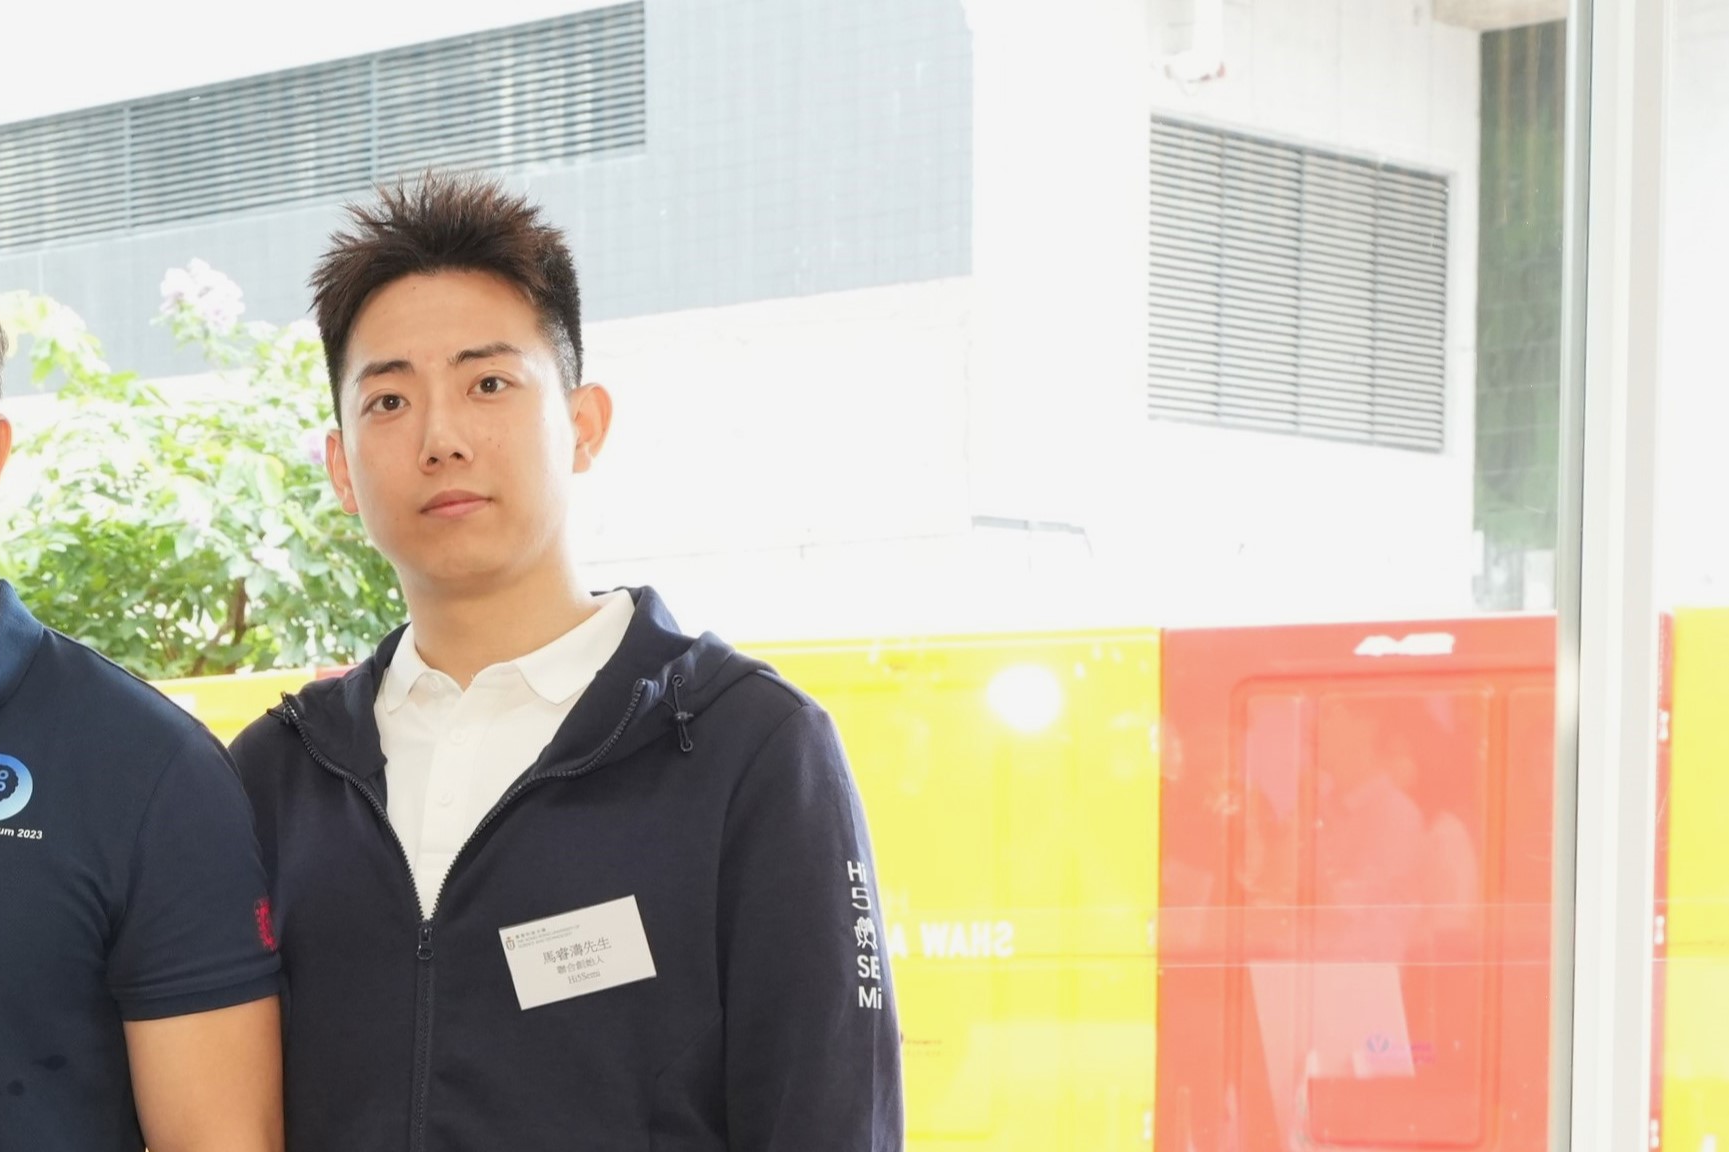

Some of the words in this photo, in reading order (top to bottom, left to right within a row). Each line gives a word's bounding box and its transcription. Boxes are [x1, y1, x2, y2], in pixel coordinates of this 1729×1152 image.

[16, 827, 44, 841] 2023
[846, 860, 868, 884] Hi
[851, 887, 872, 911] 5
[857, 954, 881, 980] SE
[858, 985, 883, 1011] Mi
